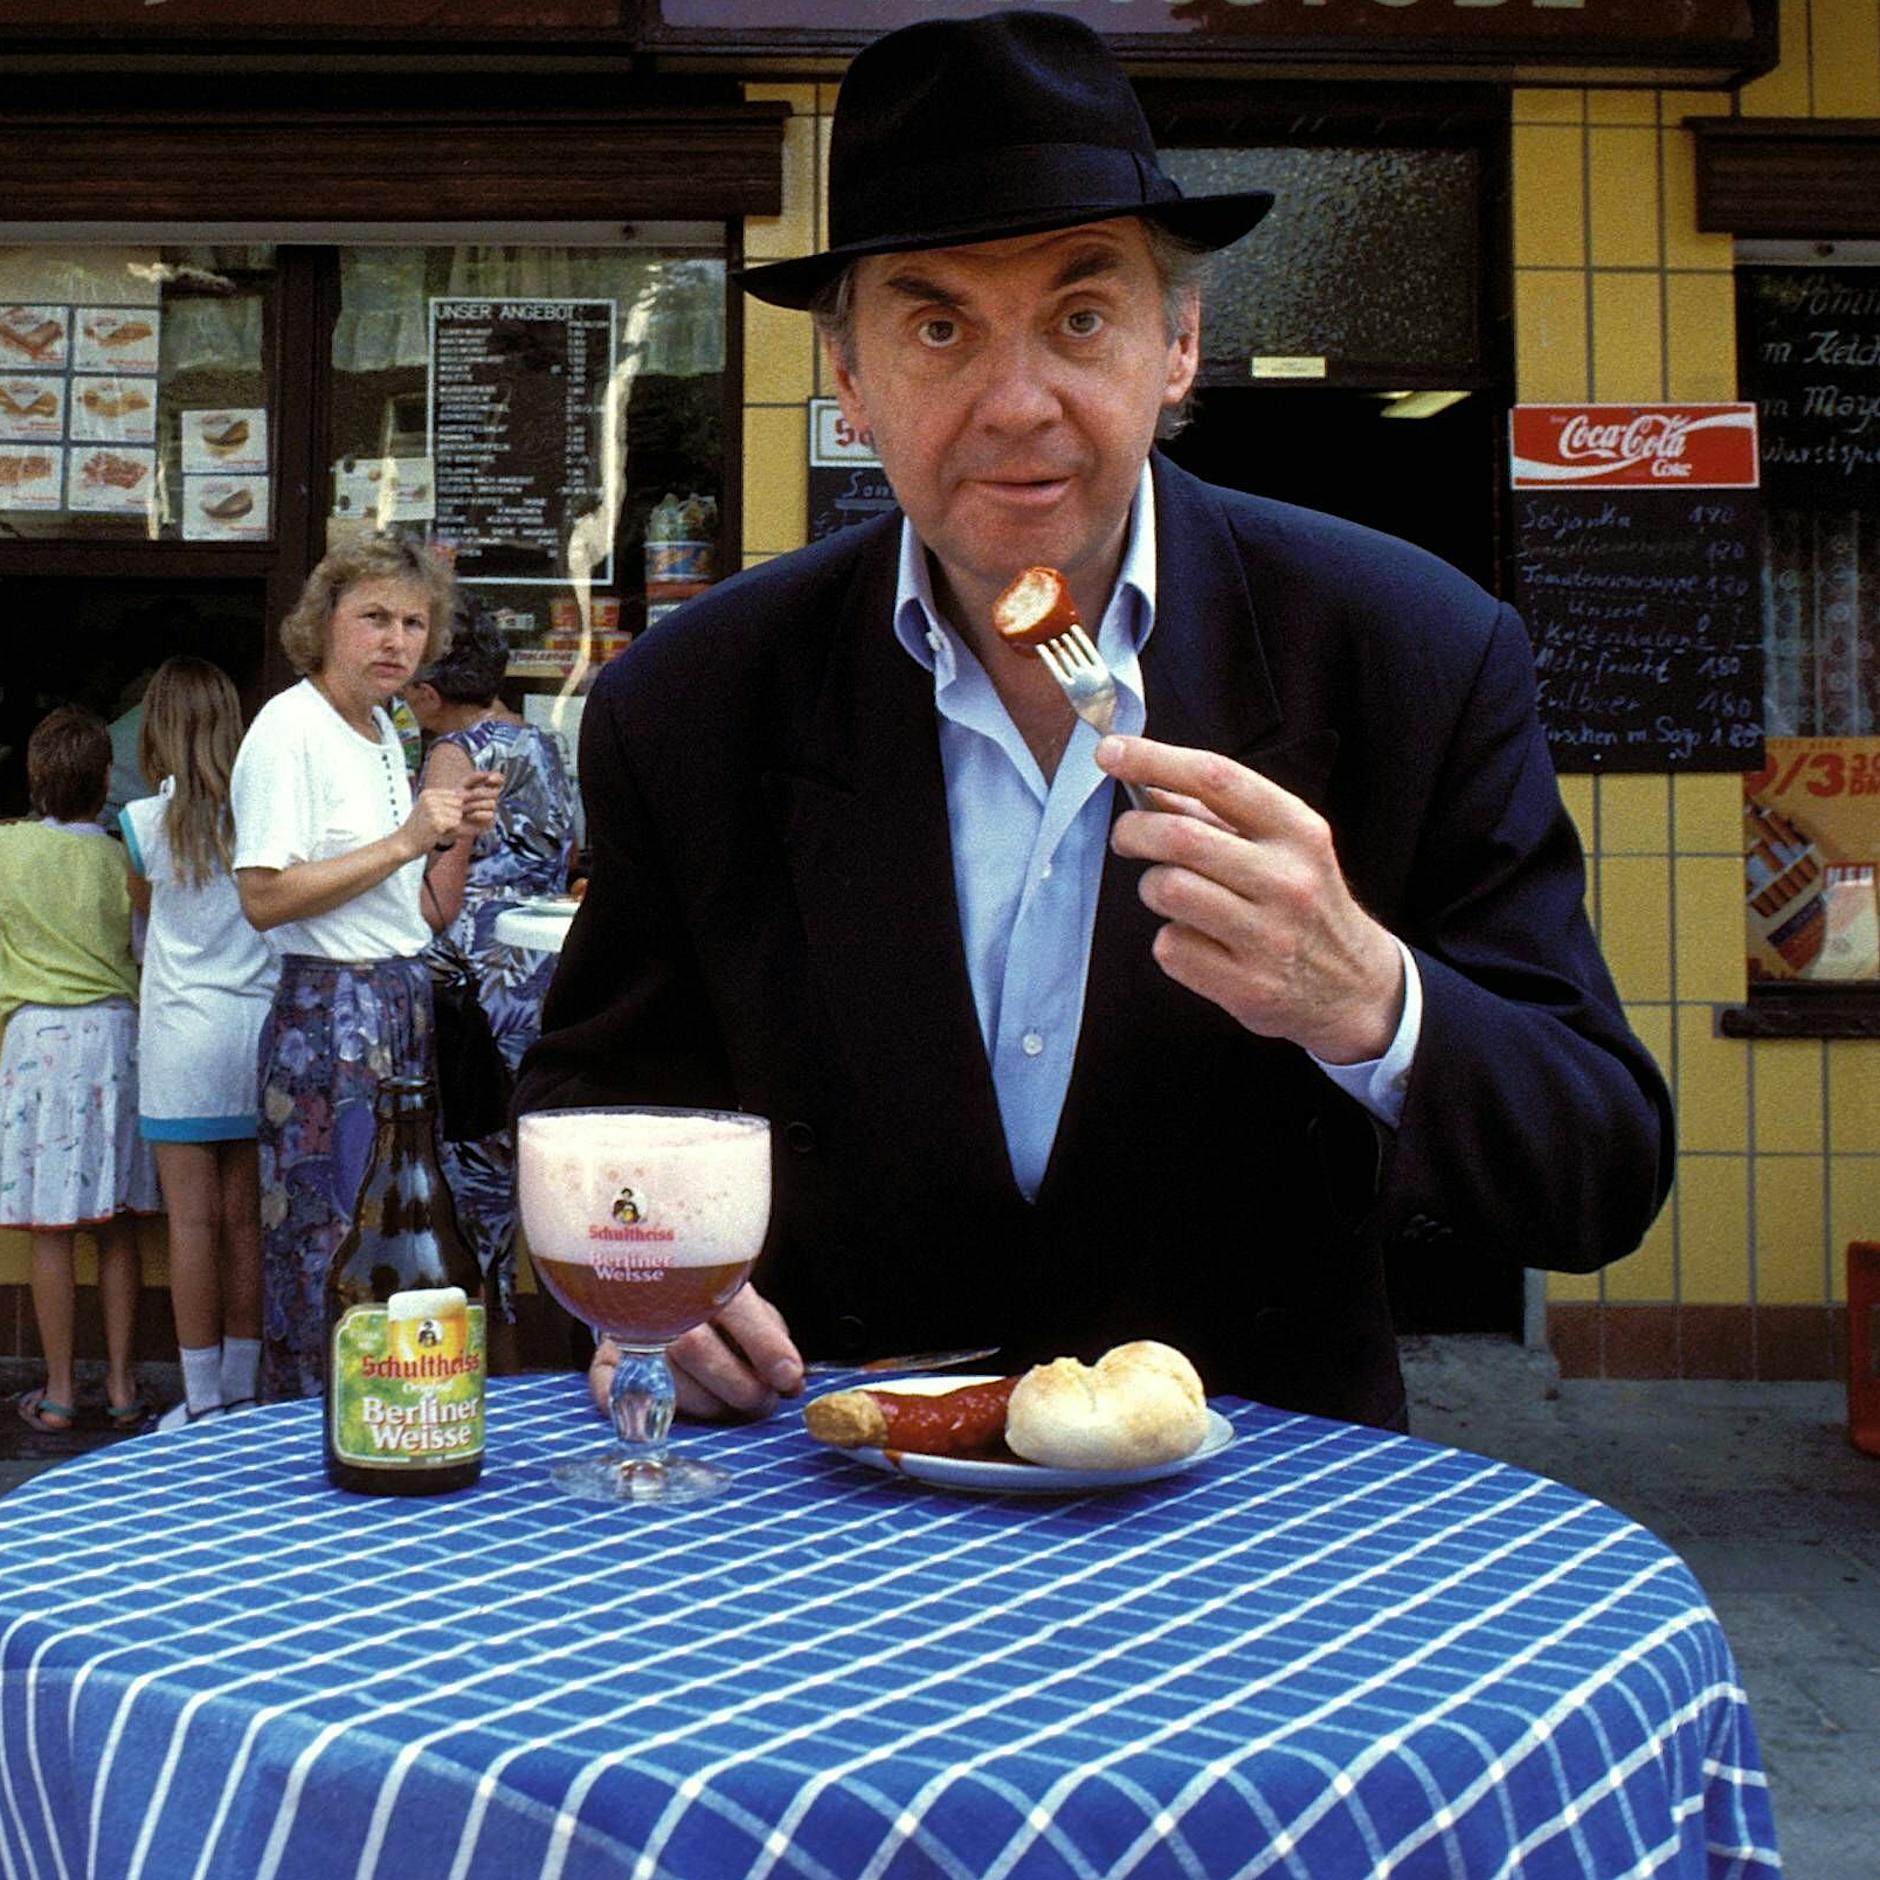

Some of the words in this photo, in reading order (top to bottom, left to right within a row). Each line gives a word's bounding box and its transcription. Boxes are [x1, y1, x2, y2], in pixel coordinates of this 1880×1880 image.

[435, 304, 491, 319] UNSER
[1558, 414, 1690, 460] Coca-Cola
[588, 1224, 676, 1243] Schultheiss
[594, 1266, 665, 1282] Weisse
[361, 1350, 481, 1379] Schultheiss
[361, 1394, 480, 1427] Berliner
[371, 1423, 474, 1451] Weisse
